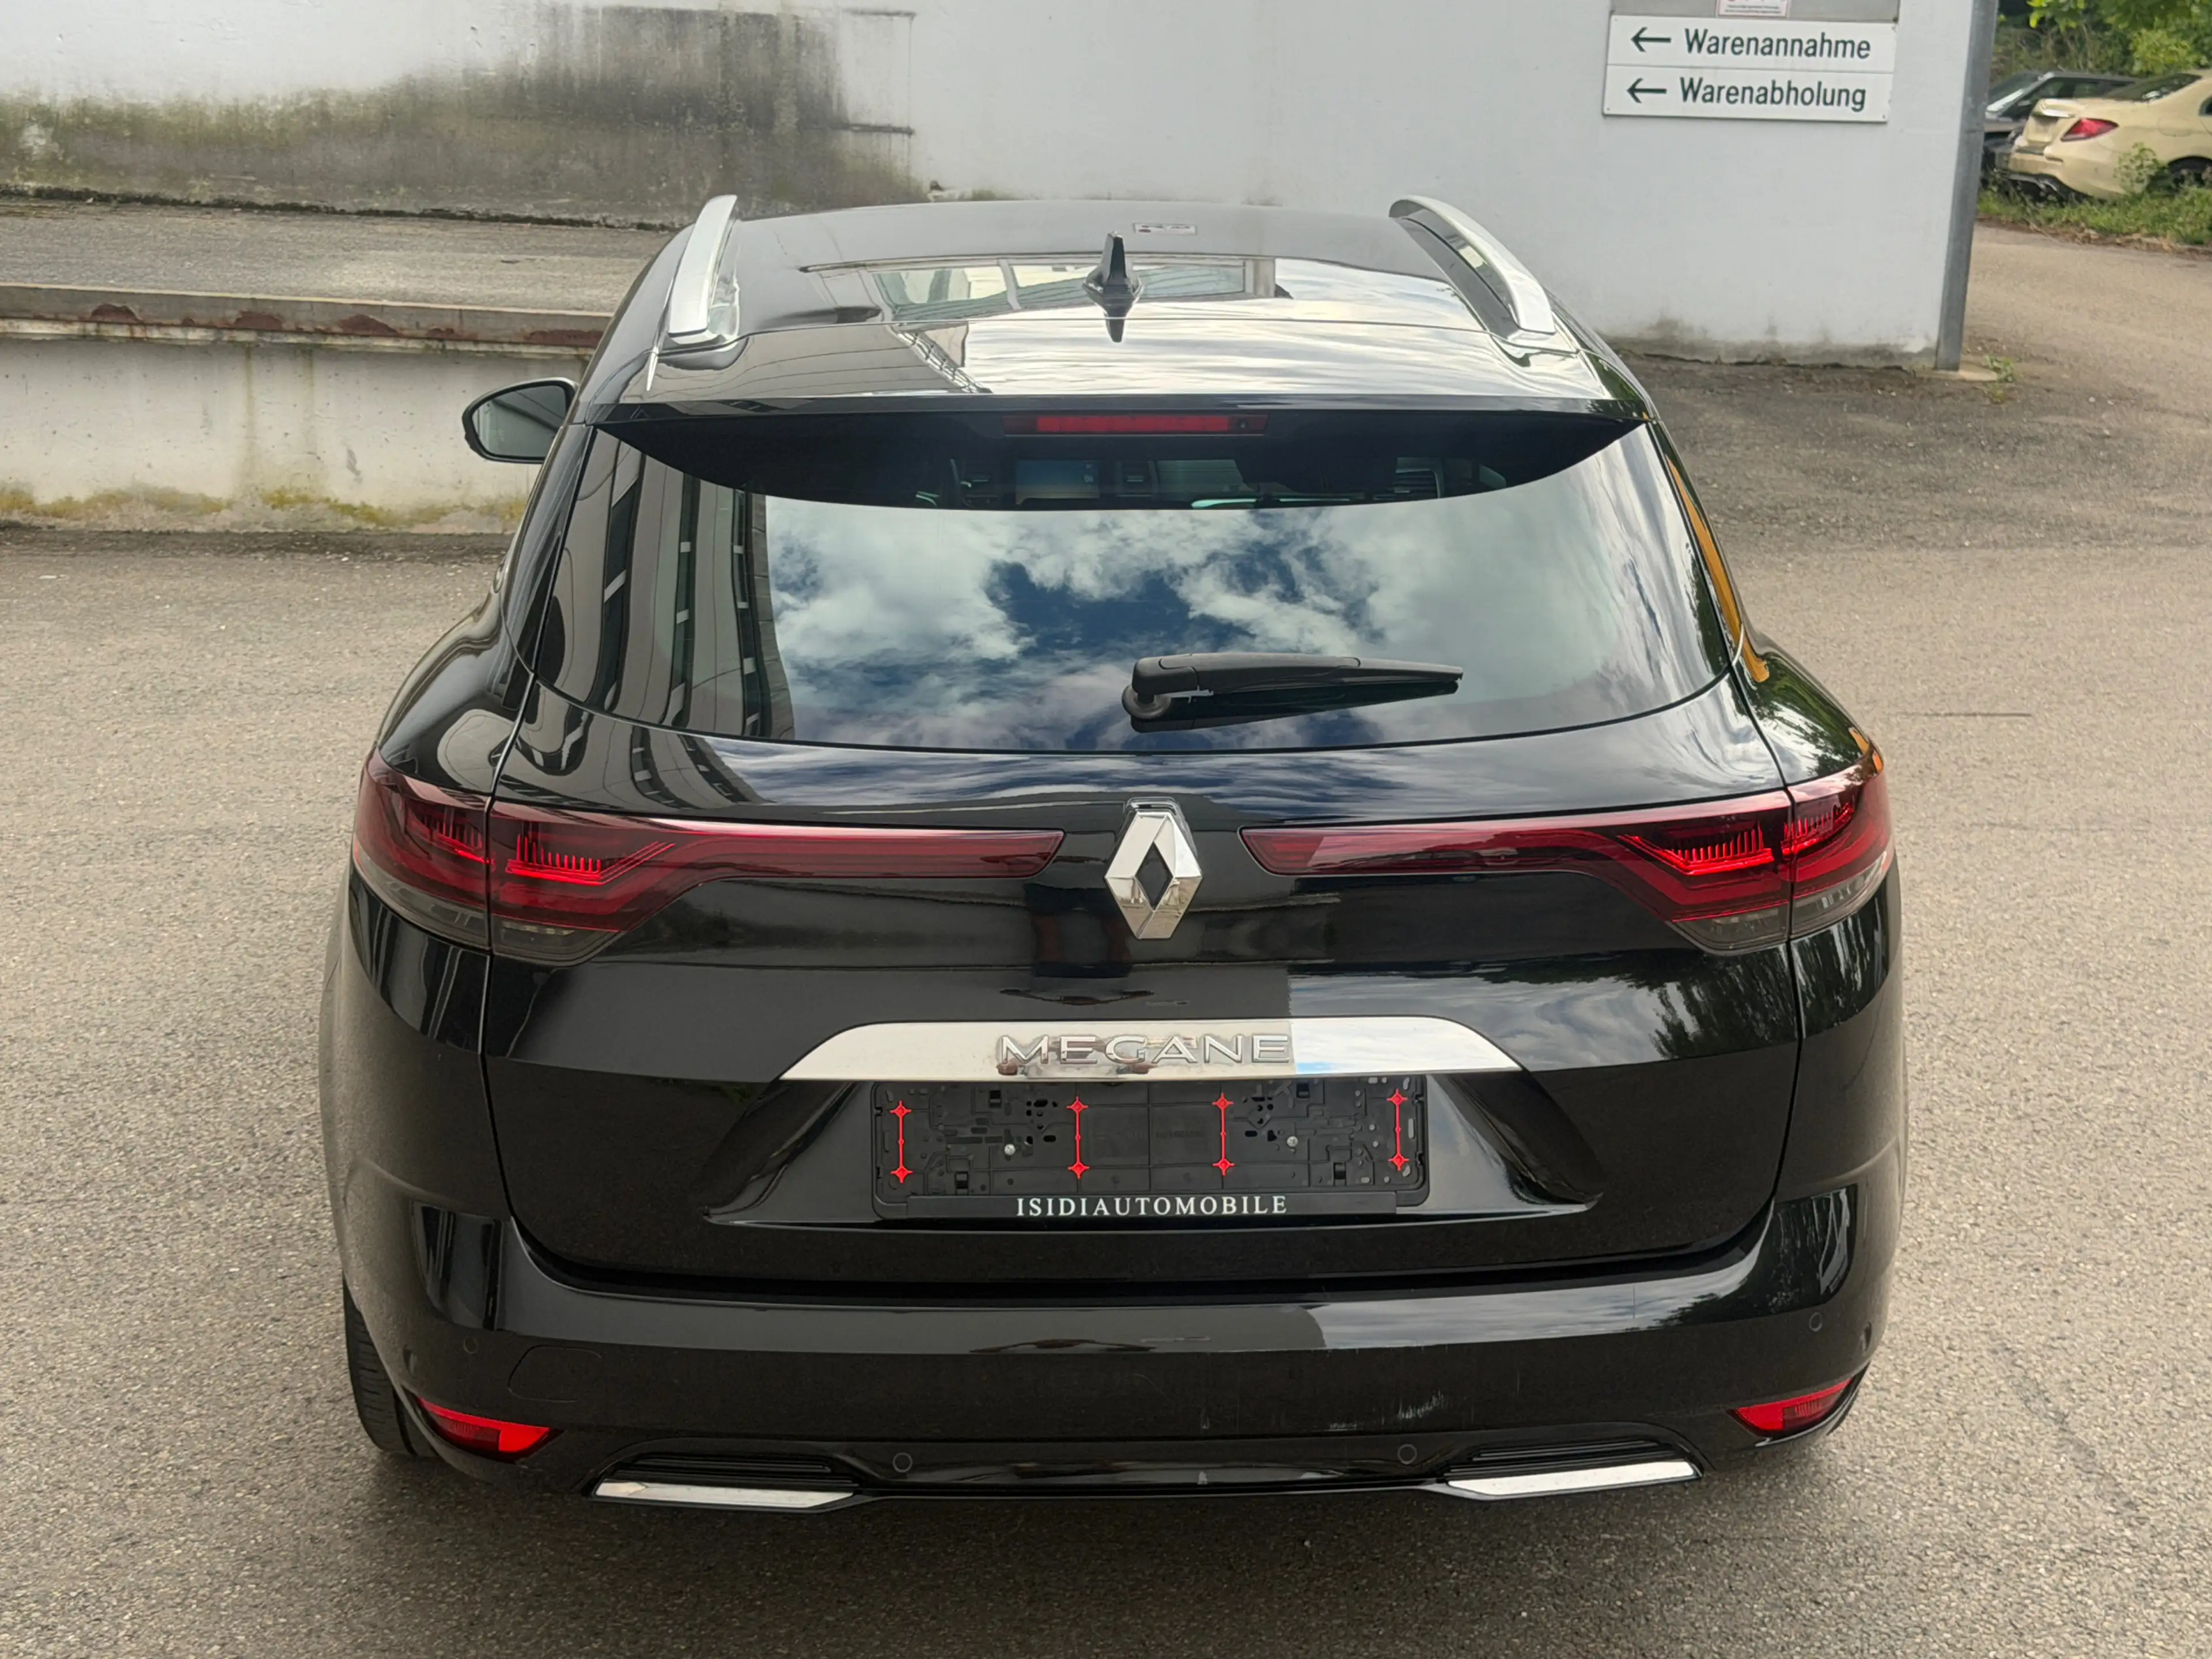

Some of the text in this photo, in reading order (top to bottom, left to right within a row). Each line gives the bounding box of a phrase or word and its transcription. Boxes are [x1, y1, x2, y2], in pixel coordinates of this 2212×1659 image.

[1684, 28, 1871, 59] Warenannahme
[1680, 77, 1866, 112] Warenabholung
[999, 1035, 1290, 1065] MEGANE
[1017, 1195, 1287, 1216] ISIDIAUTOMOBILE
